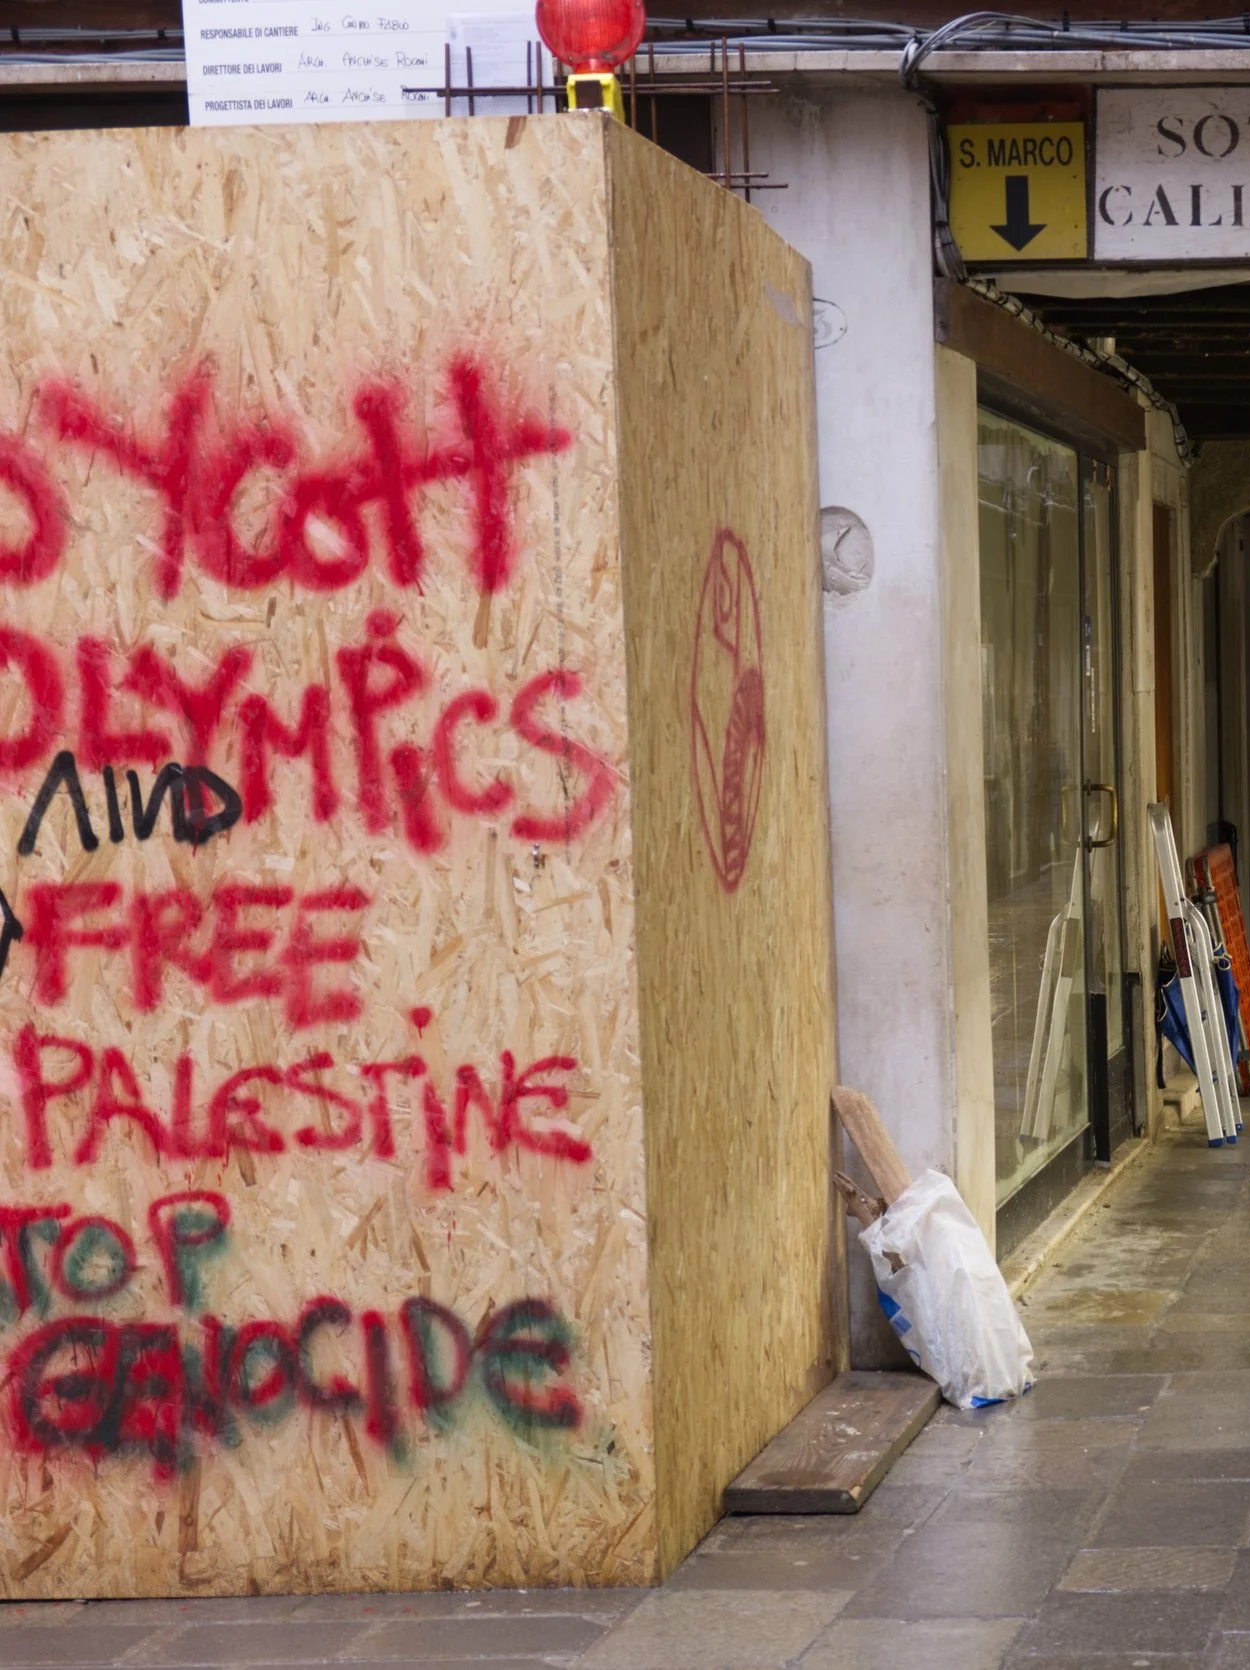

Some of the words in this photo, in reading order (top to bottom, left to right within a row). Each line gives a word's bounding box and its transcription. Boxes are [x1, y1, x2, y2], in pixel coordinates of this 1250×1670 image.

[200, 28, 253, 40] RESPONSABILE
[254, 27, 262, 38] DI
[264, 26, 299, 37] CANTIERE
[202, 64, 241, 76] DIRETTORE
[243, 64, 255, 74] DEI
[256, 62, 282, 73] LAVORI
[205, 100, 252, 111] PROGETTISTA
[254, 99, 265, 110] DEI
[267, 98, 293, 109] LAVORI
[960, 138, 981, 168] S.
[987, 136, 1073, 167] MARCO
[23, 880, 370, 1030] FREE
